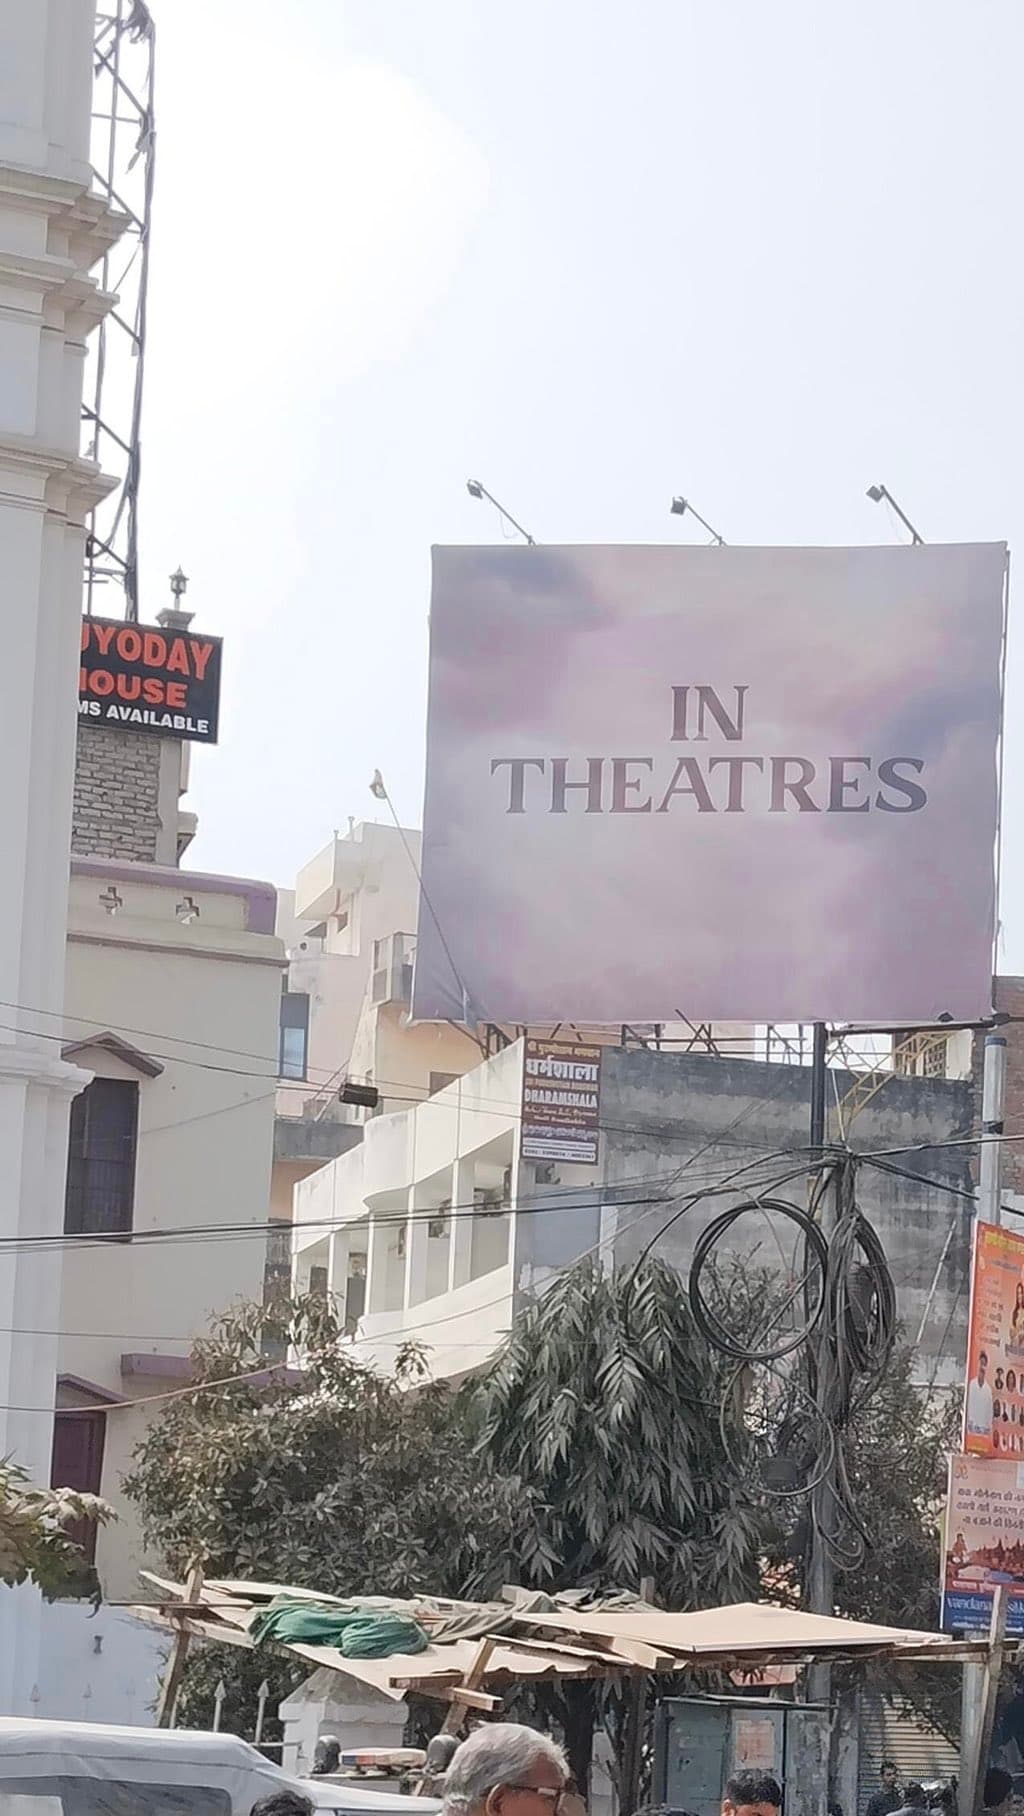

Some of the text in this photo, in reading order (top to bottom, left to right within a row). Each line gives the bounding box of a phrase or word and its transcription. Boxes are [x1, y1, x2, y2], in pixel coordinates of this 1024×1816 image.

[106, 704, 209, 734] AVAILABLE
[669, 685, 749, 741] IN
[490, 756, 928, 814] THEATRES
[524, 1088, 598, 1108] DHARAMSHALA
